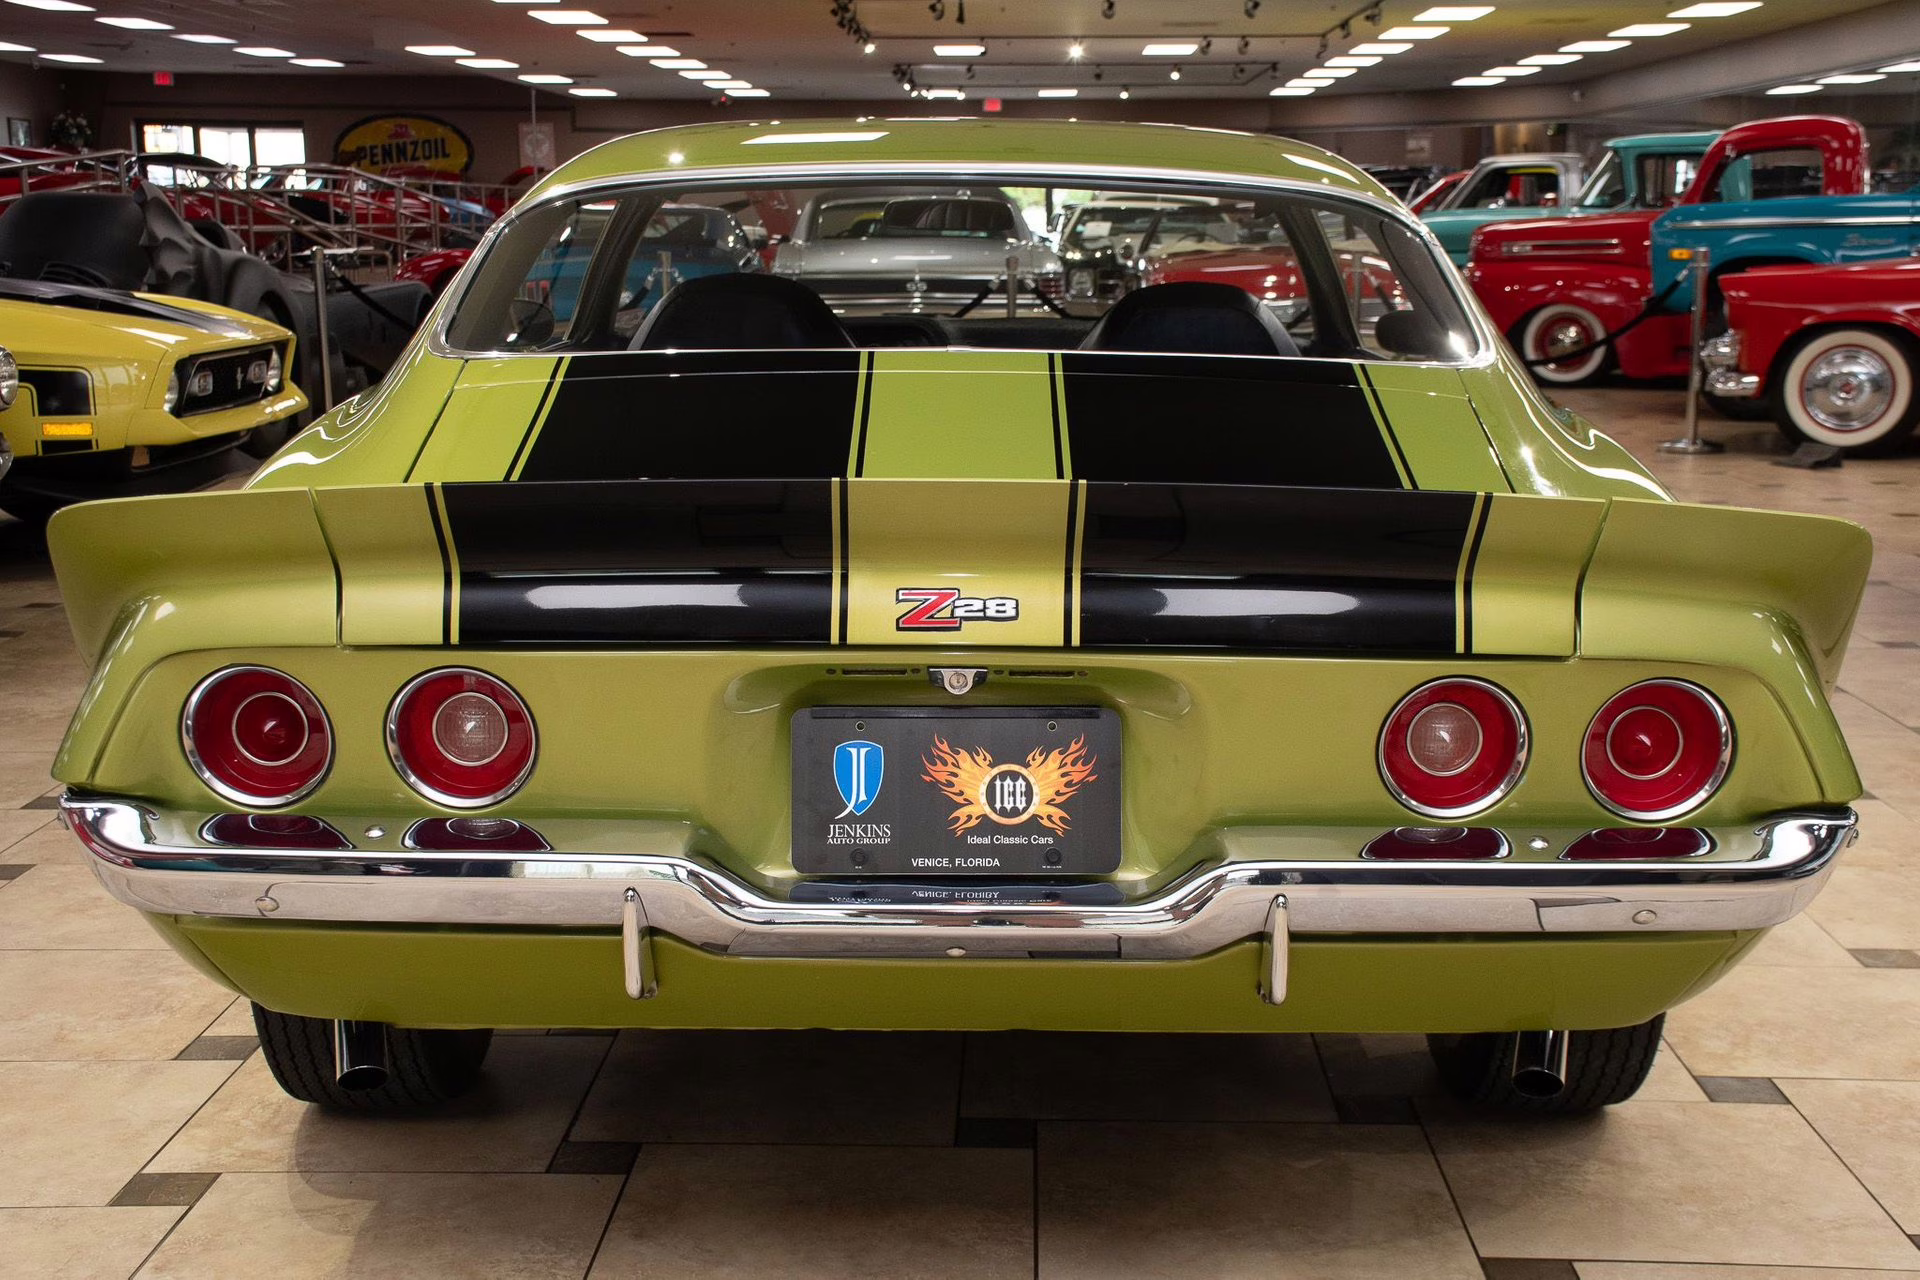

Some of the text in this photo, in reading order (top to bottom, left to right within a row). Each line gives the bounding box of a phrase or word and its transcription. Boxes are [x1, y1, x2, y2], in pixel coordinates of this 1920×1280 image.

[354, 137, 451, 167] PENNZOIL
[896, 588, 1019, 631] Z28
[827, 824, 891, 838] JENKINS
[827, 837, 891, 845] AUTO GROUP
[967, 835, 1054, 844] Ideal Classic Cars
[911, 858, 1000, 868] VENICE, FLORIDA
